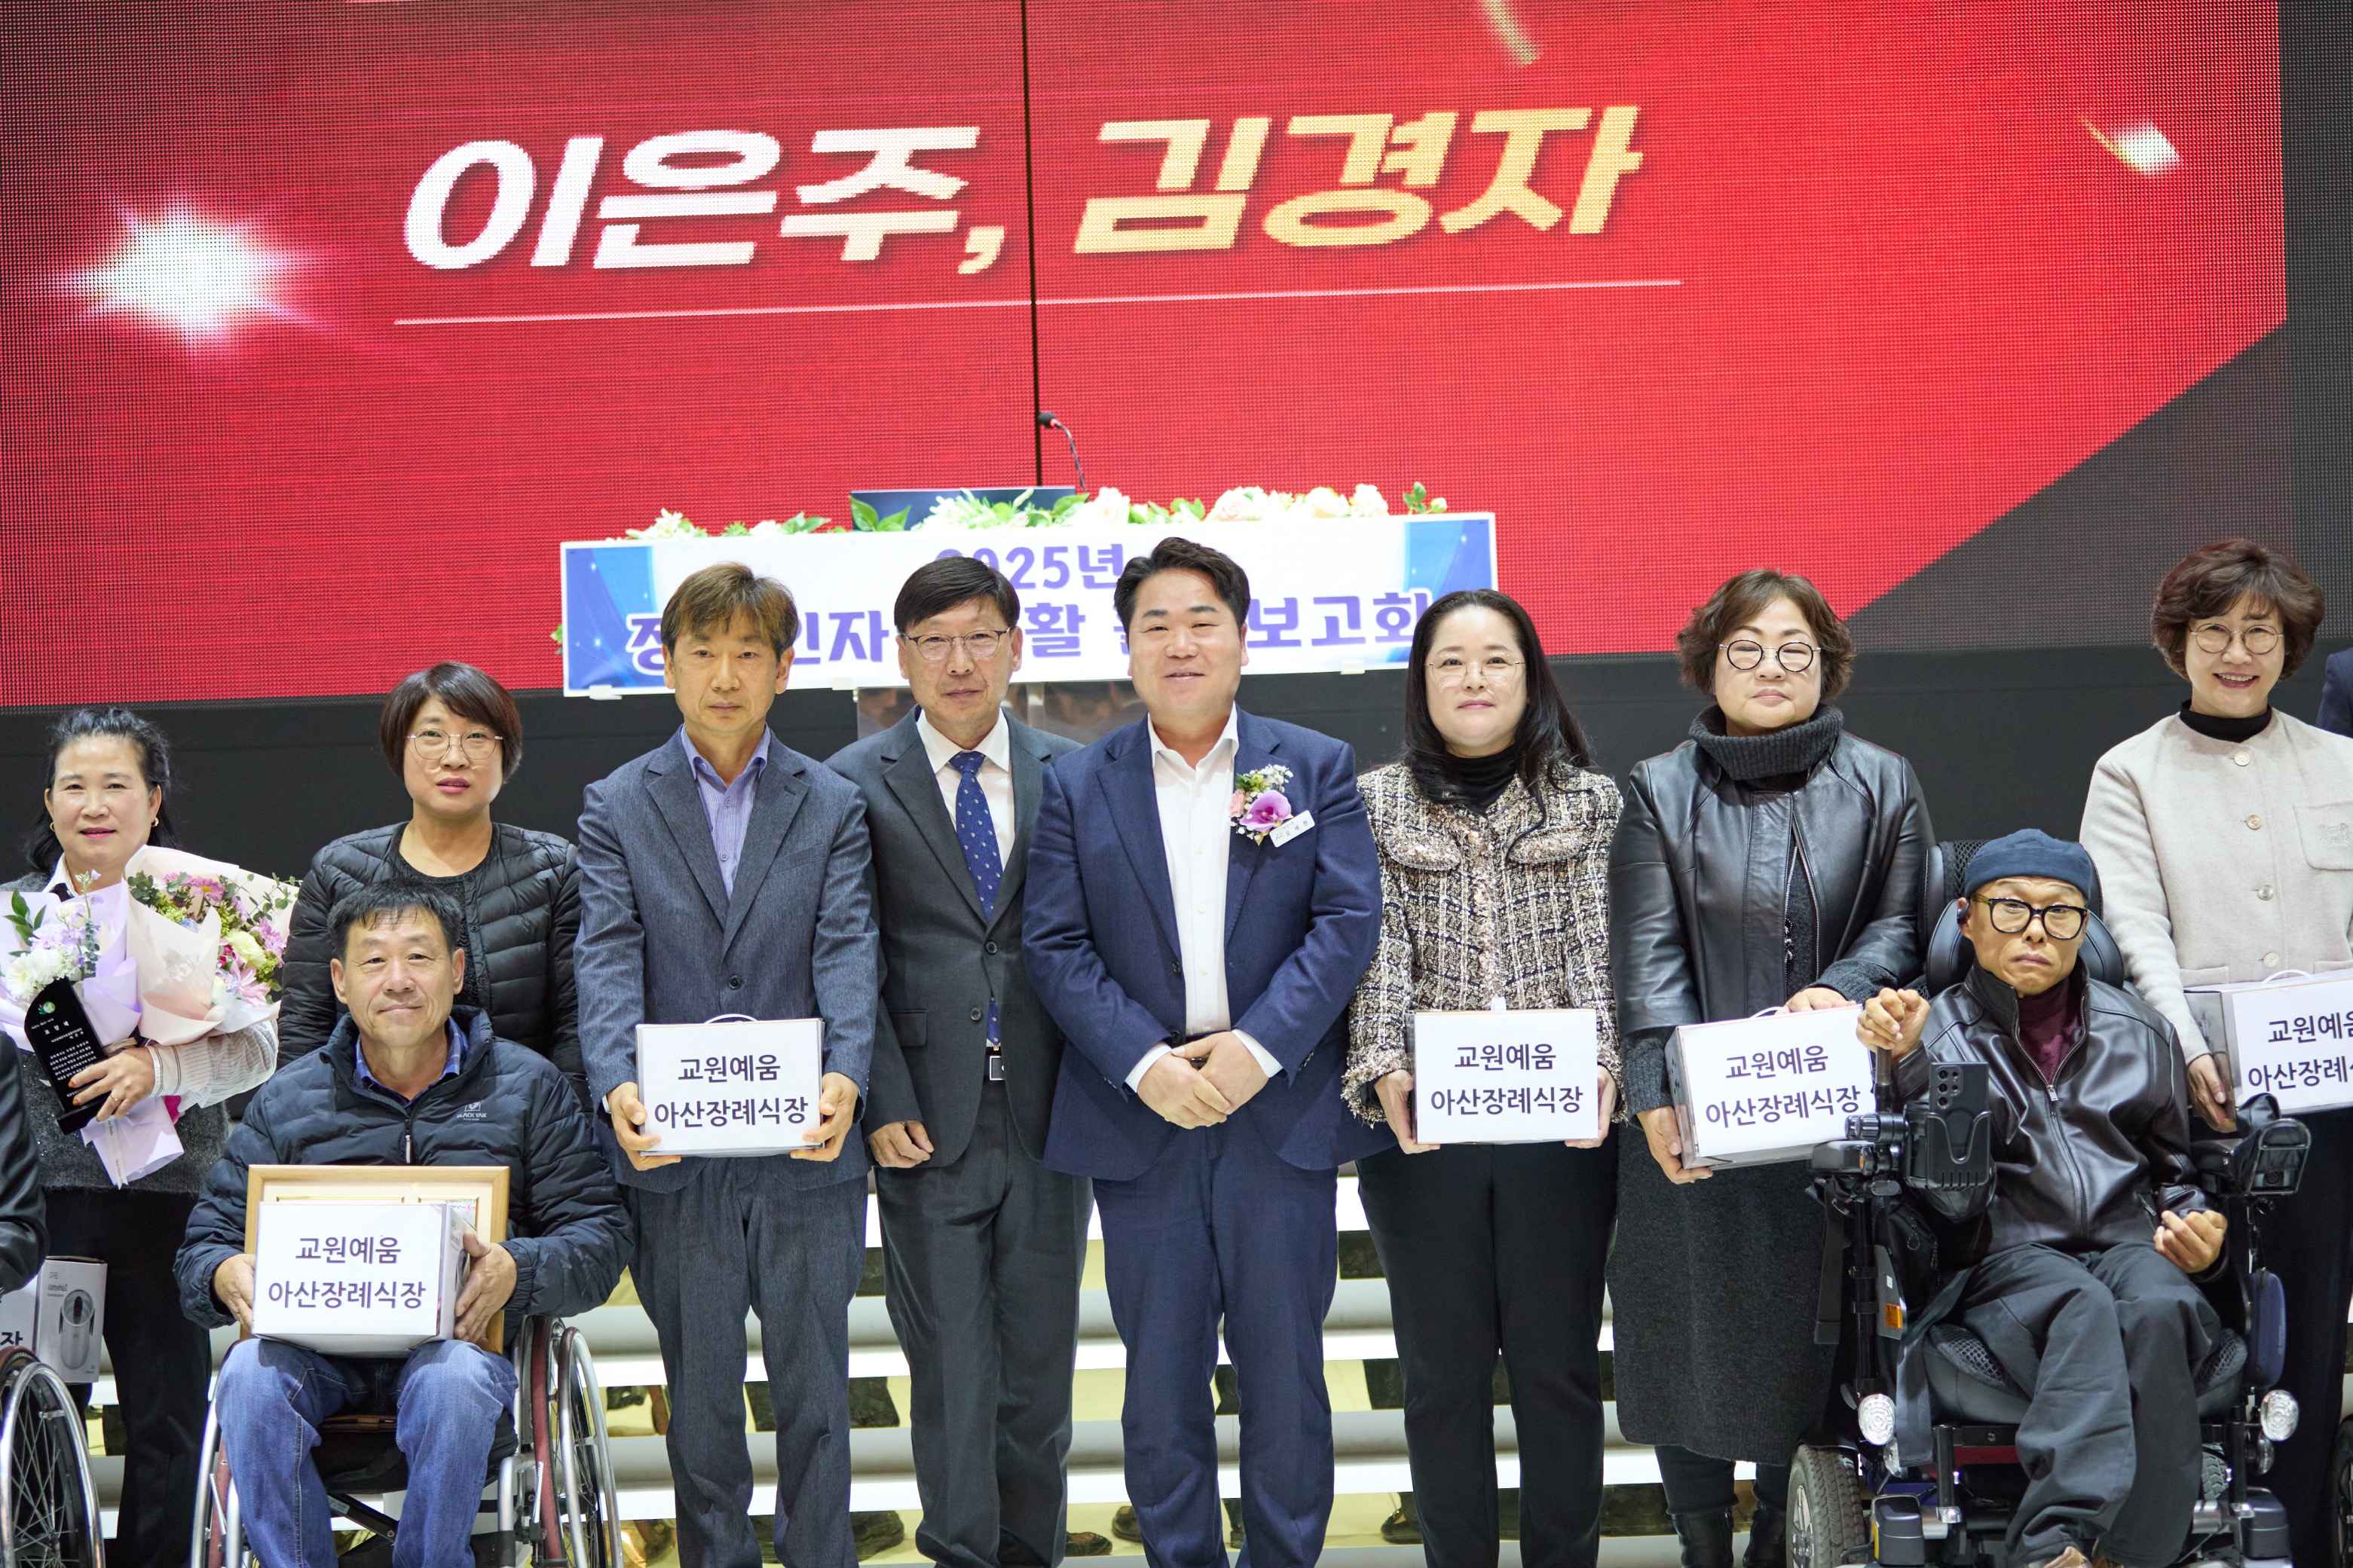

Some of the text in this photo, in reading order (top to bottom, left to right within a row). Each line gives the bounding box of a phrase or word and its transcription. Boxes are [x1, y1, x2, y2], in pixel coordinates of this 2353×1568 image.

[404, 106, 1645, 275] 이은주, 김경자
[678, 1054, 781, 1084] 교원예움
[1454, 1044, 1556, 1071] 교원예움
[1726, 1045, 1828, 1079] 교원예움
[2247, 1055, 2353, 1093] 아산장례
[654, 1096, 809, 1129] 아산장례식장
[1430, 1086, 1583, 1116] 아산장례식장
[1706, 1085, 1861, 1129] 아산장례식장
[295, 1236, 401, 1264] 교원예움
[268, 1280, 426, 1309] 아산장례식장
